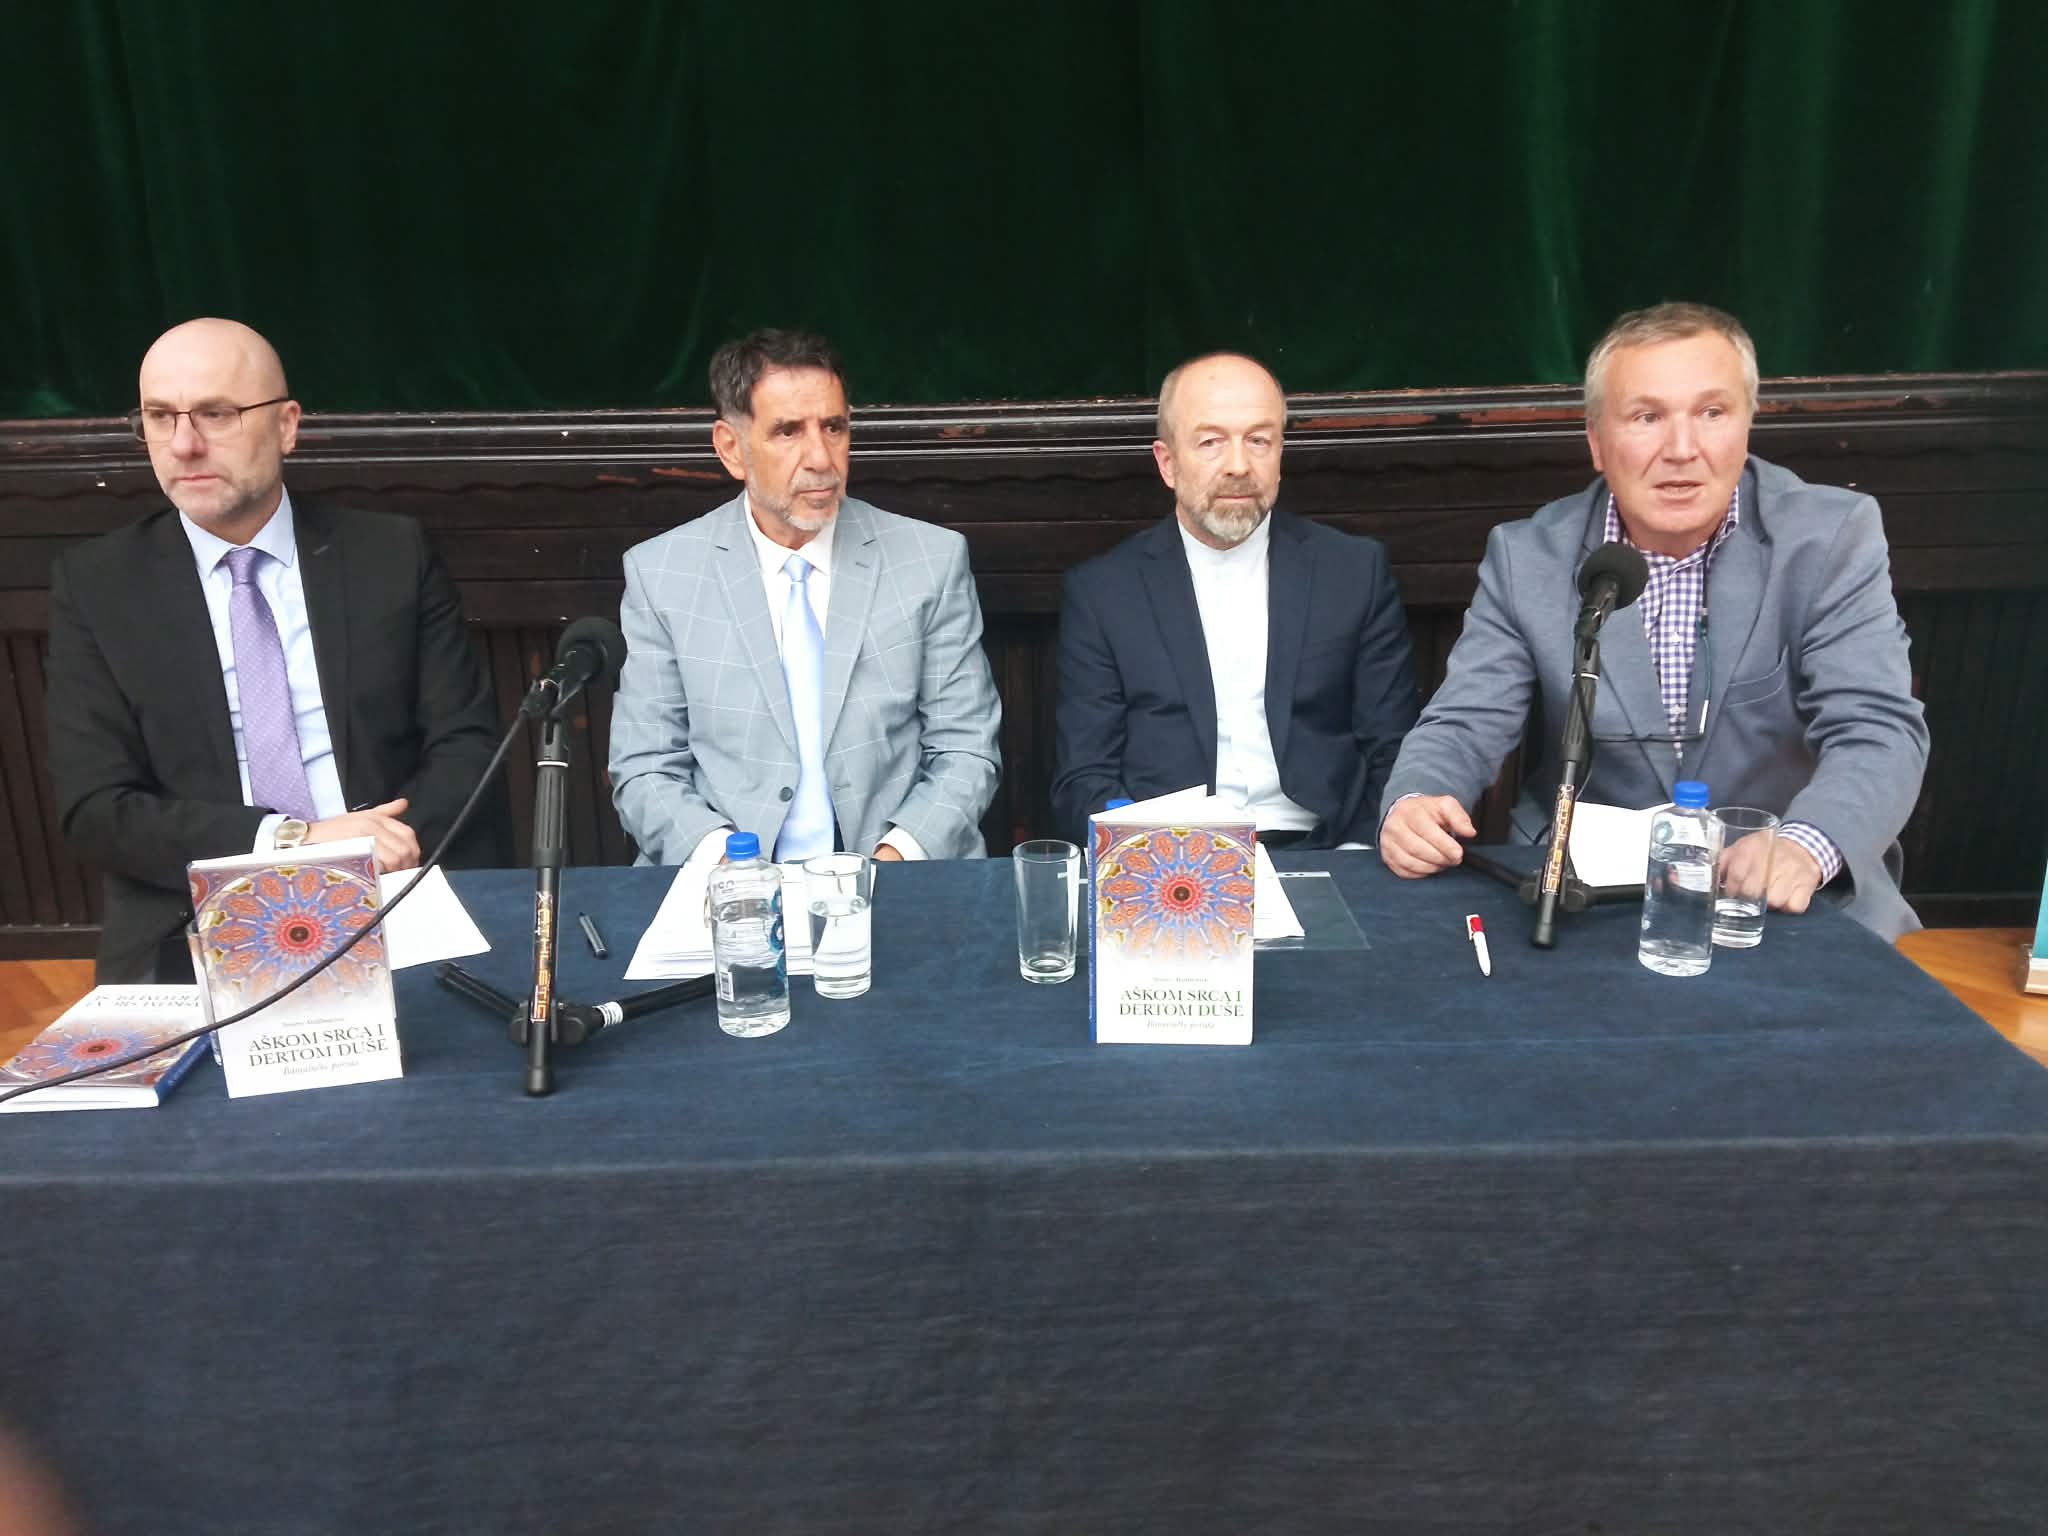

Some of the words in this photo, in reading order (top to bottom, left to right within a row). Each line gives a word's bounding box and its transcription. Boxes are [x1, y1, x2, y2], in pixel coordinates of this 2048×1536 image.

[1121, 985, 1182, 1001] AŠKOM
[1187, 989, 1232, 1002] SRCA
[1236, 990, 1242, 1002] I
[1119, 1003, 1193, 1016] DERTOM
[1199, 1002, 1244, 1017] DUŠE
[249, 1031, 319, 1052] AŠKOM
[323, 1026, 374, 1043] SRCA
[377, 1023, 385, 1036] I
[249, 1045, 333, 1067] DERTOM
[338, 1037, 389, 1056] DUŠE
